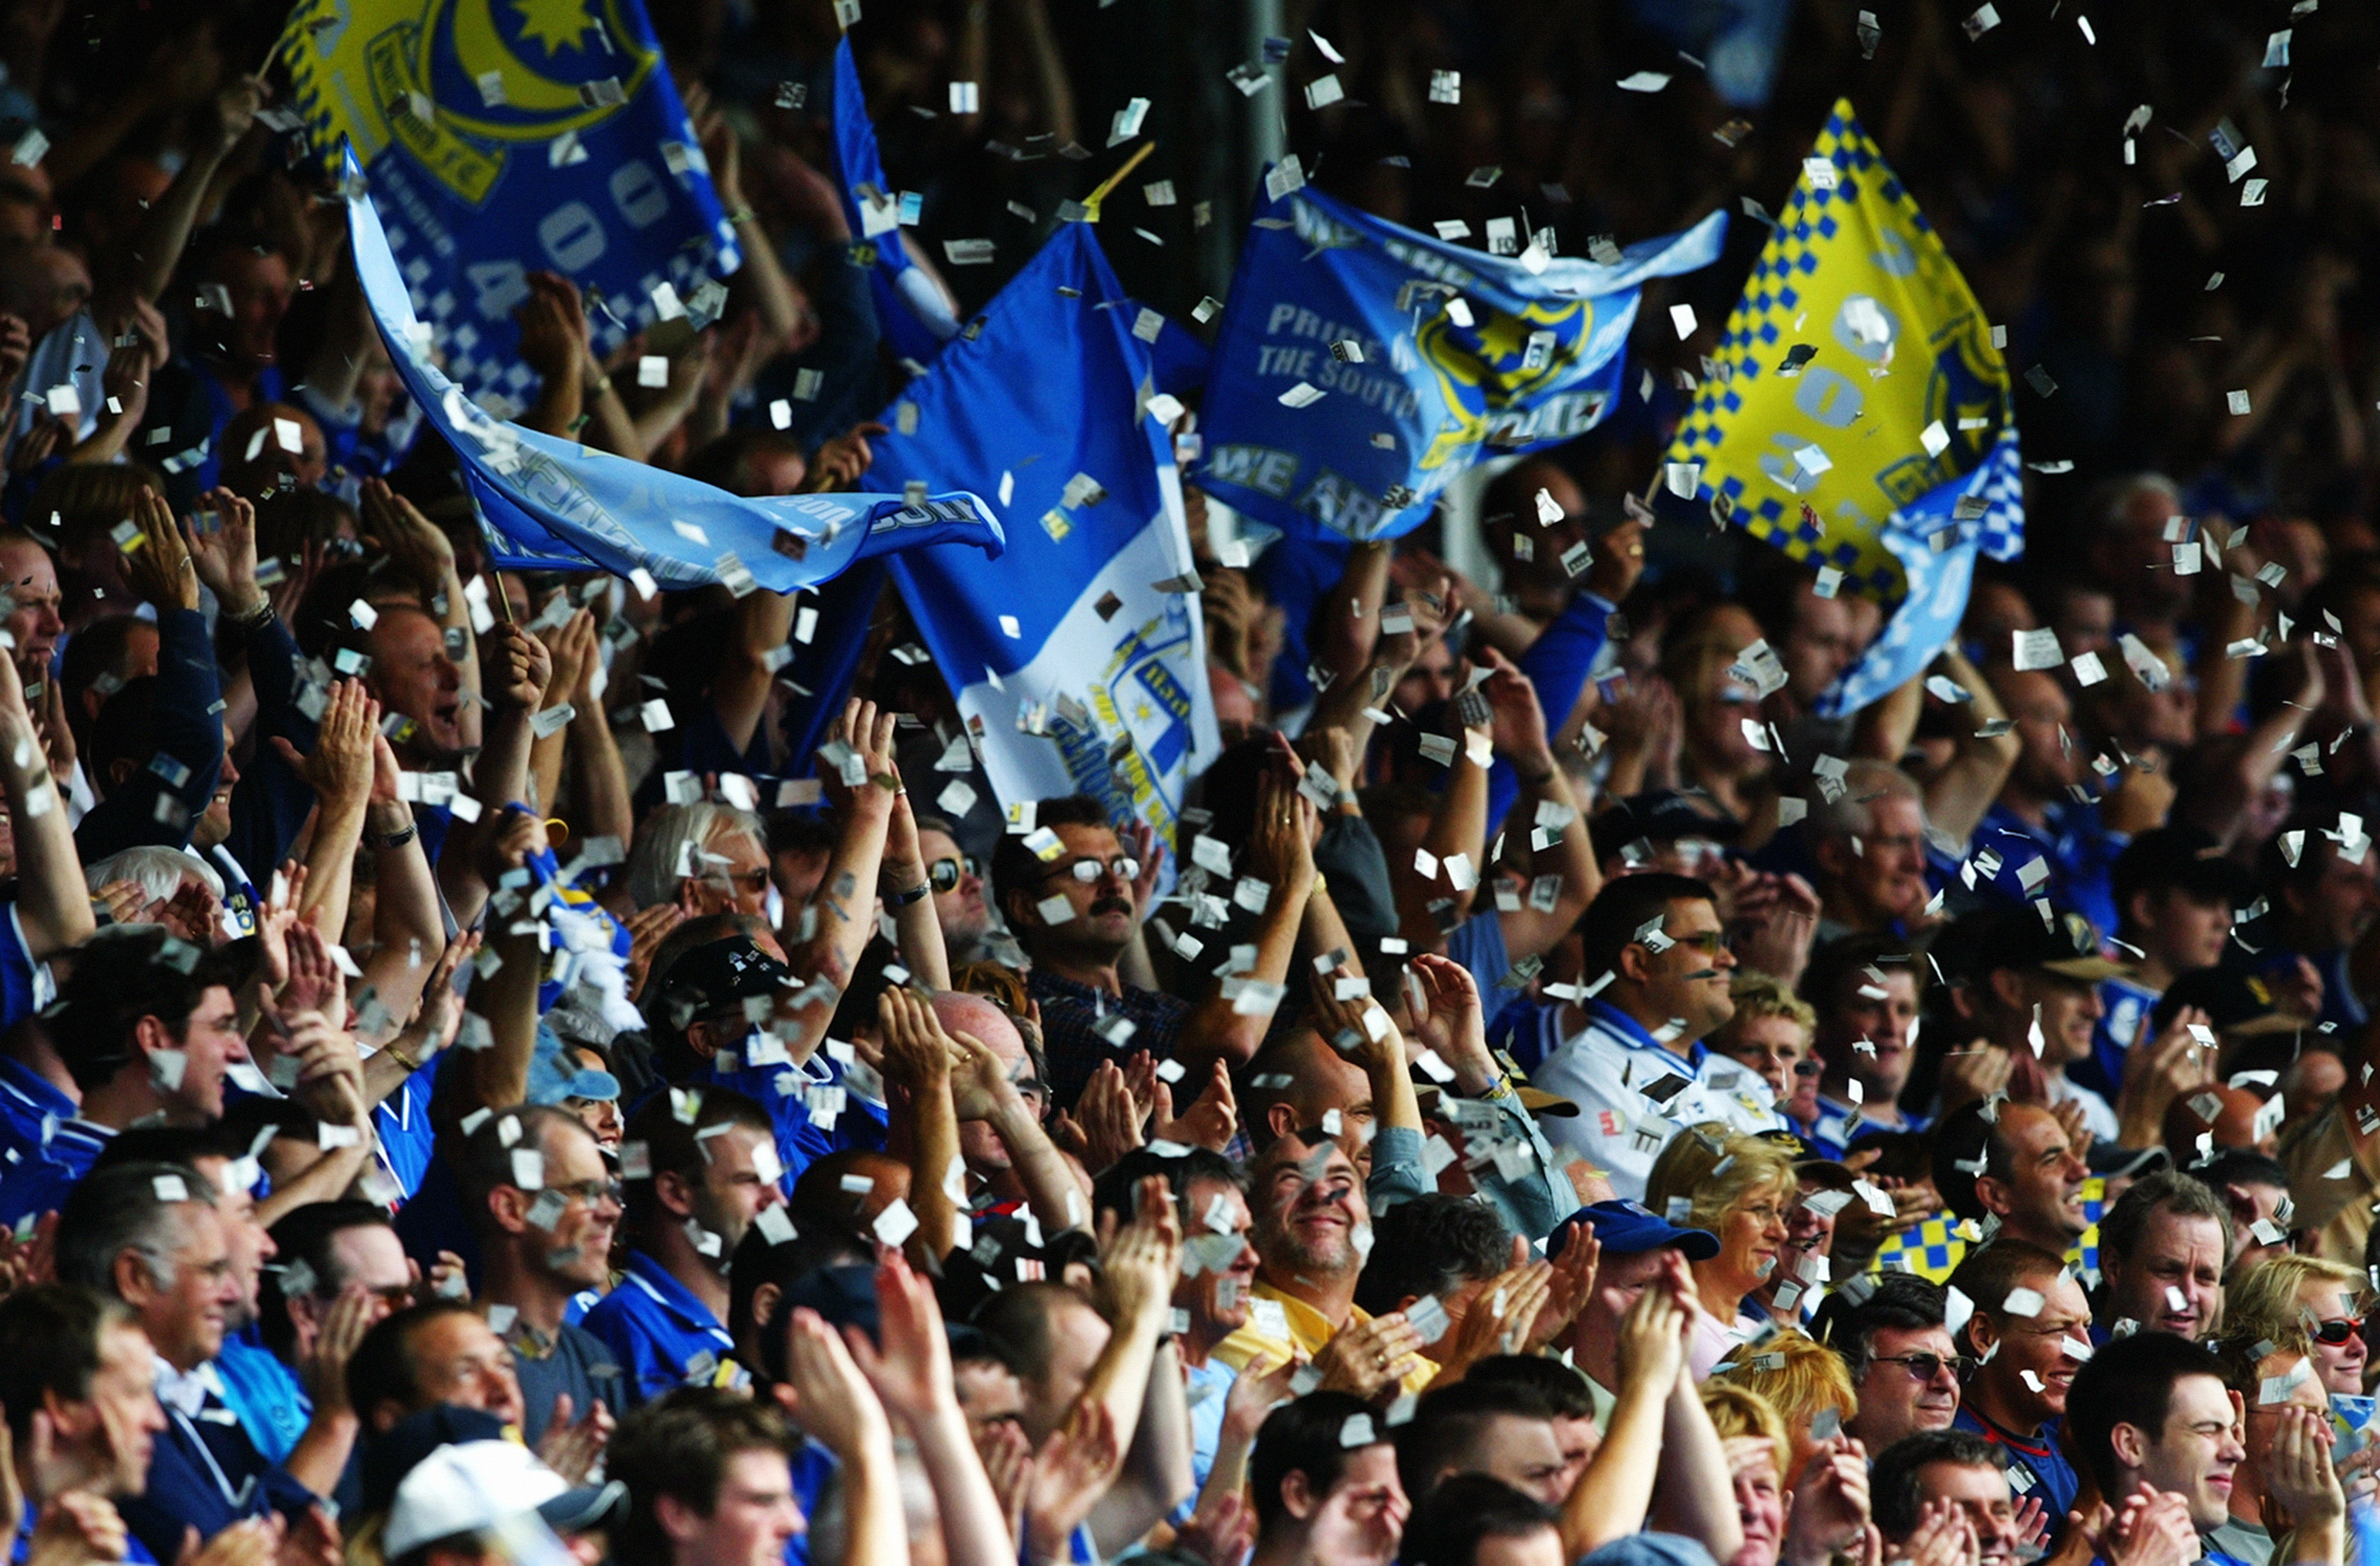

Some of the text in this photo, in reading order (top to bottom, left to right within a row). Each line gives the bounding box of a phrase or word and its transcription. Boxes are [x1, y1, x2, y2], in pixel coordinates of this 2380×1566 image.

[1257, 344, 1312, 382] THE
[1317, 361, 1421, 421] SOUTH
[1213, 446, 1295, 496] WE
